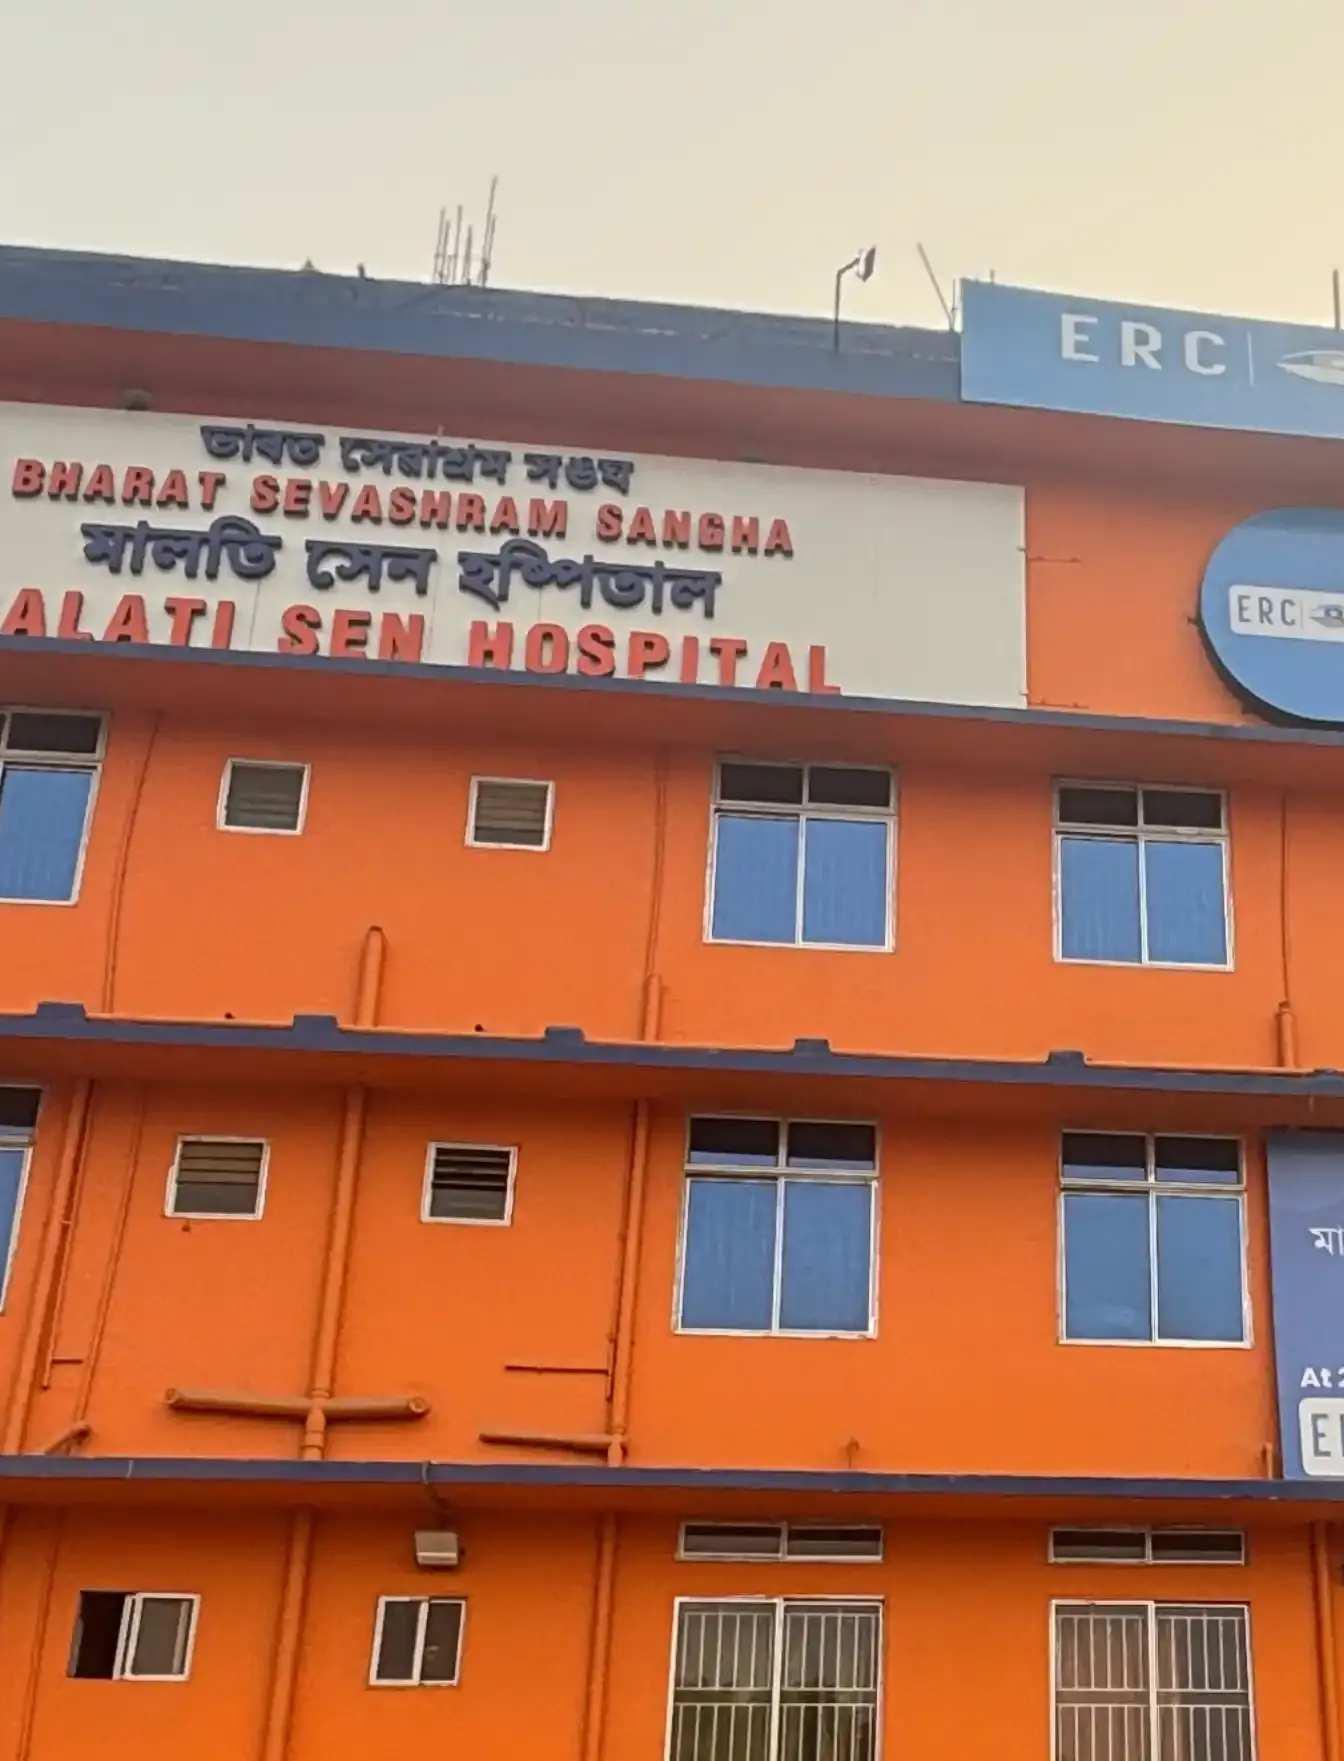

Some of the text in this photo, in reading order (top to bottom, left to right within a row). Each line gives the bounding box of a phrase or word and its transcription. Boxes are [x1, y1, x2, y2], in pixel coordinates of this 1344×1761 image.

[1061, 313, 1226, 375] ERC
[11, 458, 794, 558] BHARAT SEVASHRAM SANGHA
[80, 515, 282, 580] মালতি
[305, 538, 437, 595] সেন
[1237, 594, 1296, 626] ERC
[278, 604, 424, 663] SEN
[467, 620, 842, 695] HOSPITAL
[1300, 1367, 1333, 1389] At
